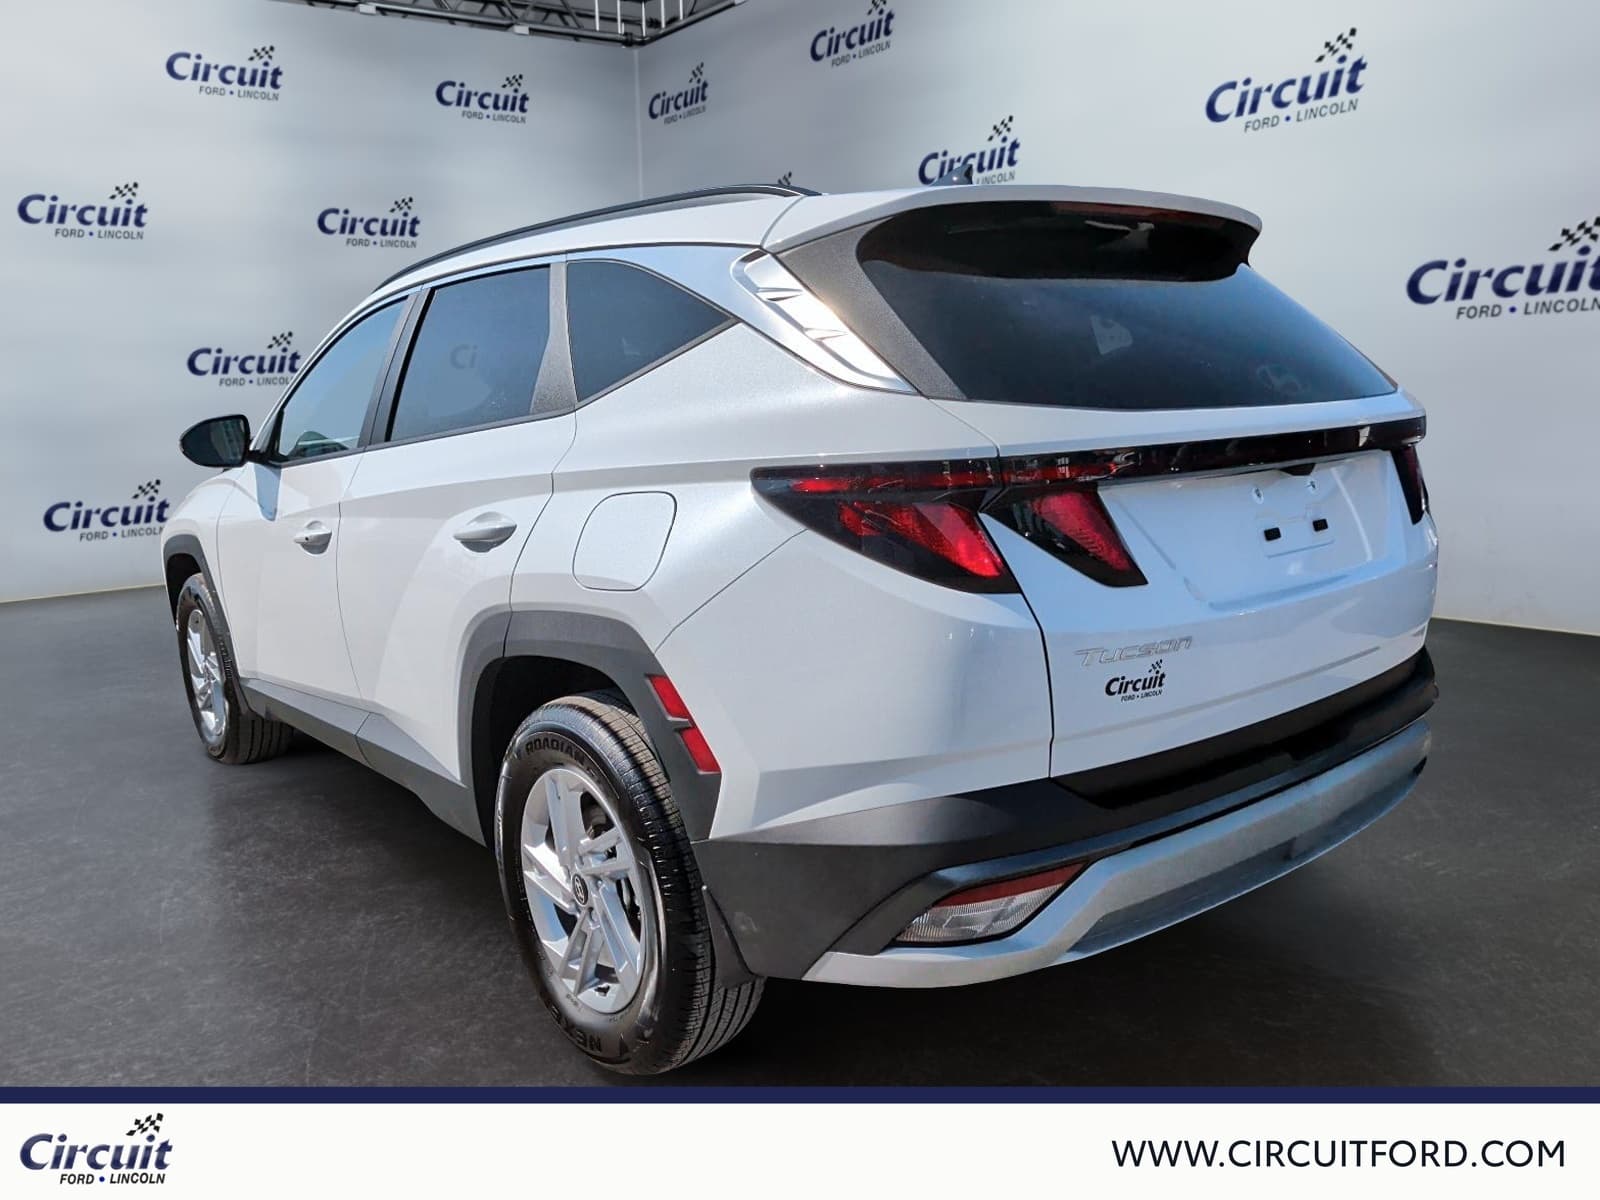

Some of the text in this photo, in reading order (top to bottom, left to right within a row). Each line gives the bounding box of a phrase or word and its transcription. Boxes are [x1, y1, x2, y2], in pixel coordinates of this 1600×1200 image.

[809, 8, 895, 62] Circuit
[831, 40, 891, 68] FORD LINCOLN
[165, 51, 283, 90] Circuit
[199, 85, 279, 101] FORD LINCOLN
[435, 80, 530, 114] Circuit
[648, 78, 708, 120] Circuit
[1205, 54, 1368, 123] Circuit
[462, 110, 526, 124] FORD LINCOLN
[1244, 98, 1359, 133] FORD LINCOLN
[17, 193, 148, 228] Circuit
[317, 207, 421, 238] Circuit
[54, 228, 144, 240] FORD LINCOLN
[346, 238, 417, 249] FORD LINCOLN
[1406, 245, 1600, 305] Circuit
[1456, 297, 1600, 320] FORD LINCOLN
[186, 346, 301, 377] Circuit
[218, 376, 293, 387] FORD LINCOL
[43, 495, 170, 532] Circuit
[79, 531, 109, 542] FORD
[1073, 635, 1193, 667] TUCSON
[1104, 670, 1166, 697] Circuit
[525, 737, 585, 765] ROADIAN
